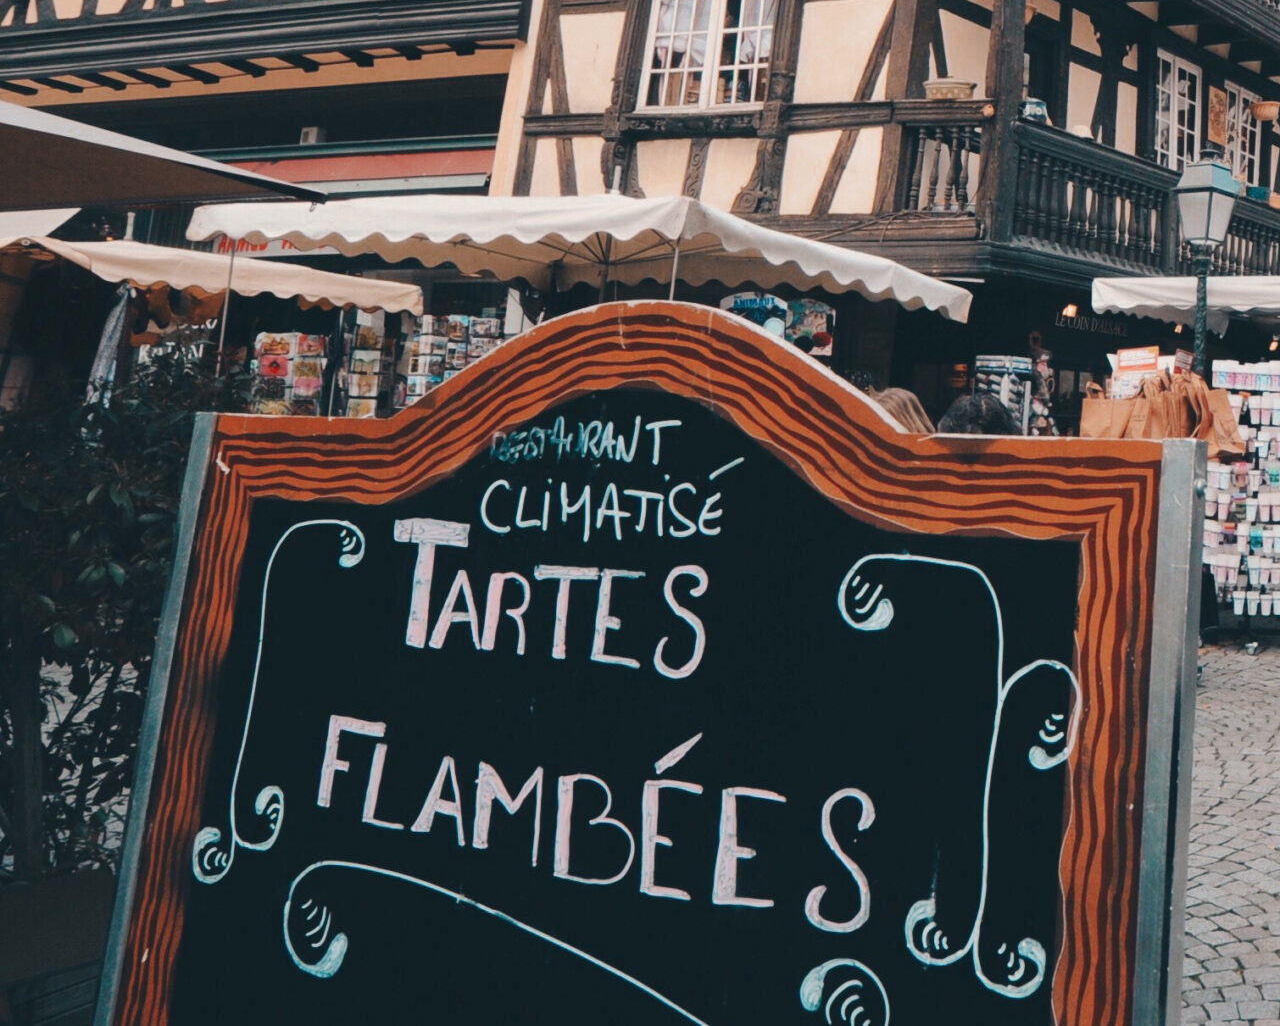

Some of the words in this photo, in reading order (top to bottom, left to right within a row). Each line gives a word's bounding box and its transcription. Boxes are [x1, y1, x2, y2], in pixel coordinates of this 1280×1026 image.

[480, 457, 745, 543] CLIMATISÉ
[394, 518, 709, 679] TARTES
[317, 715, 876, 932] FLAMBÉES
